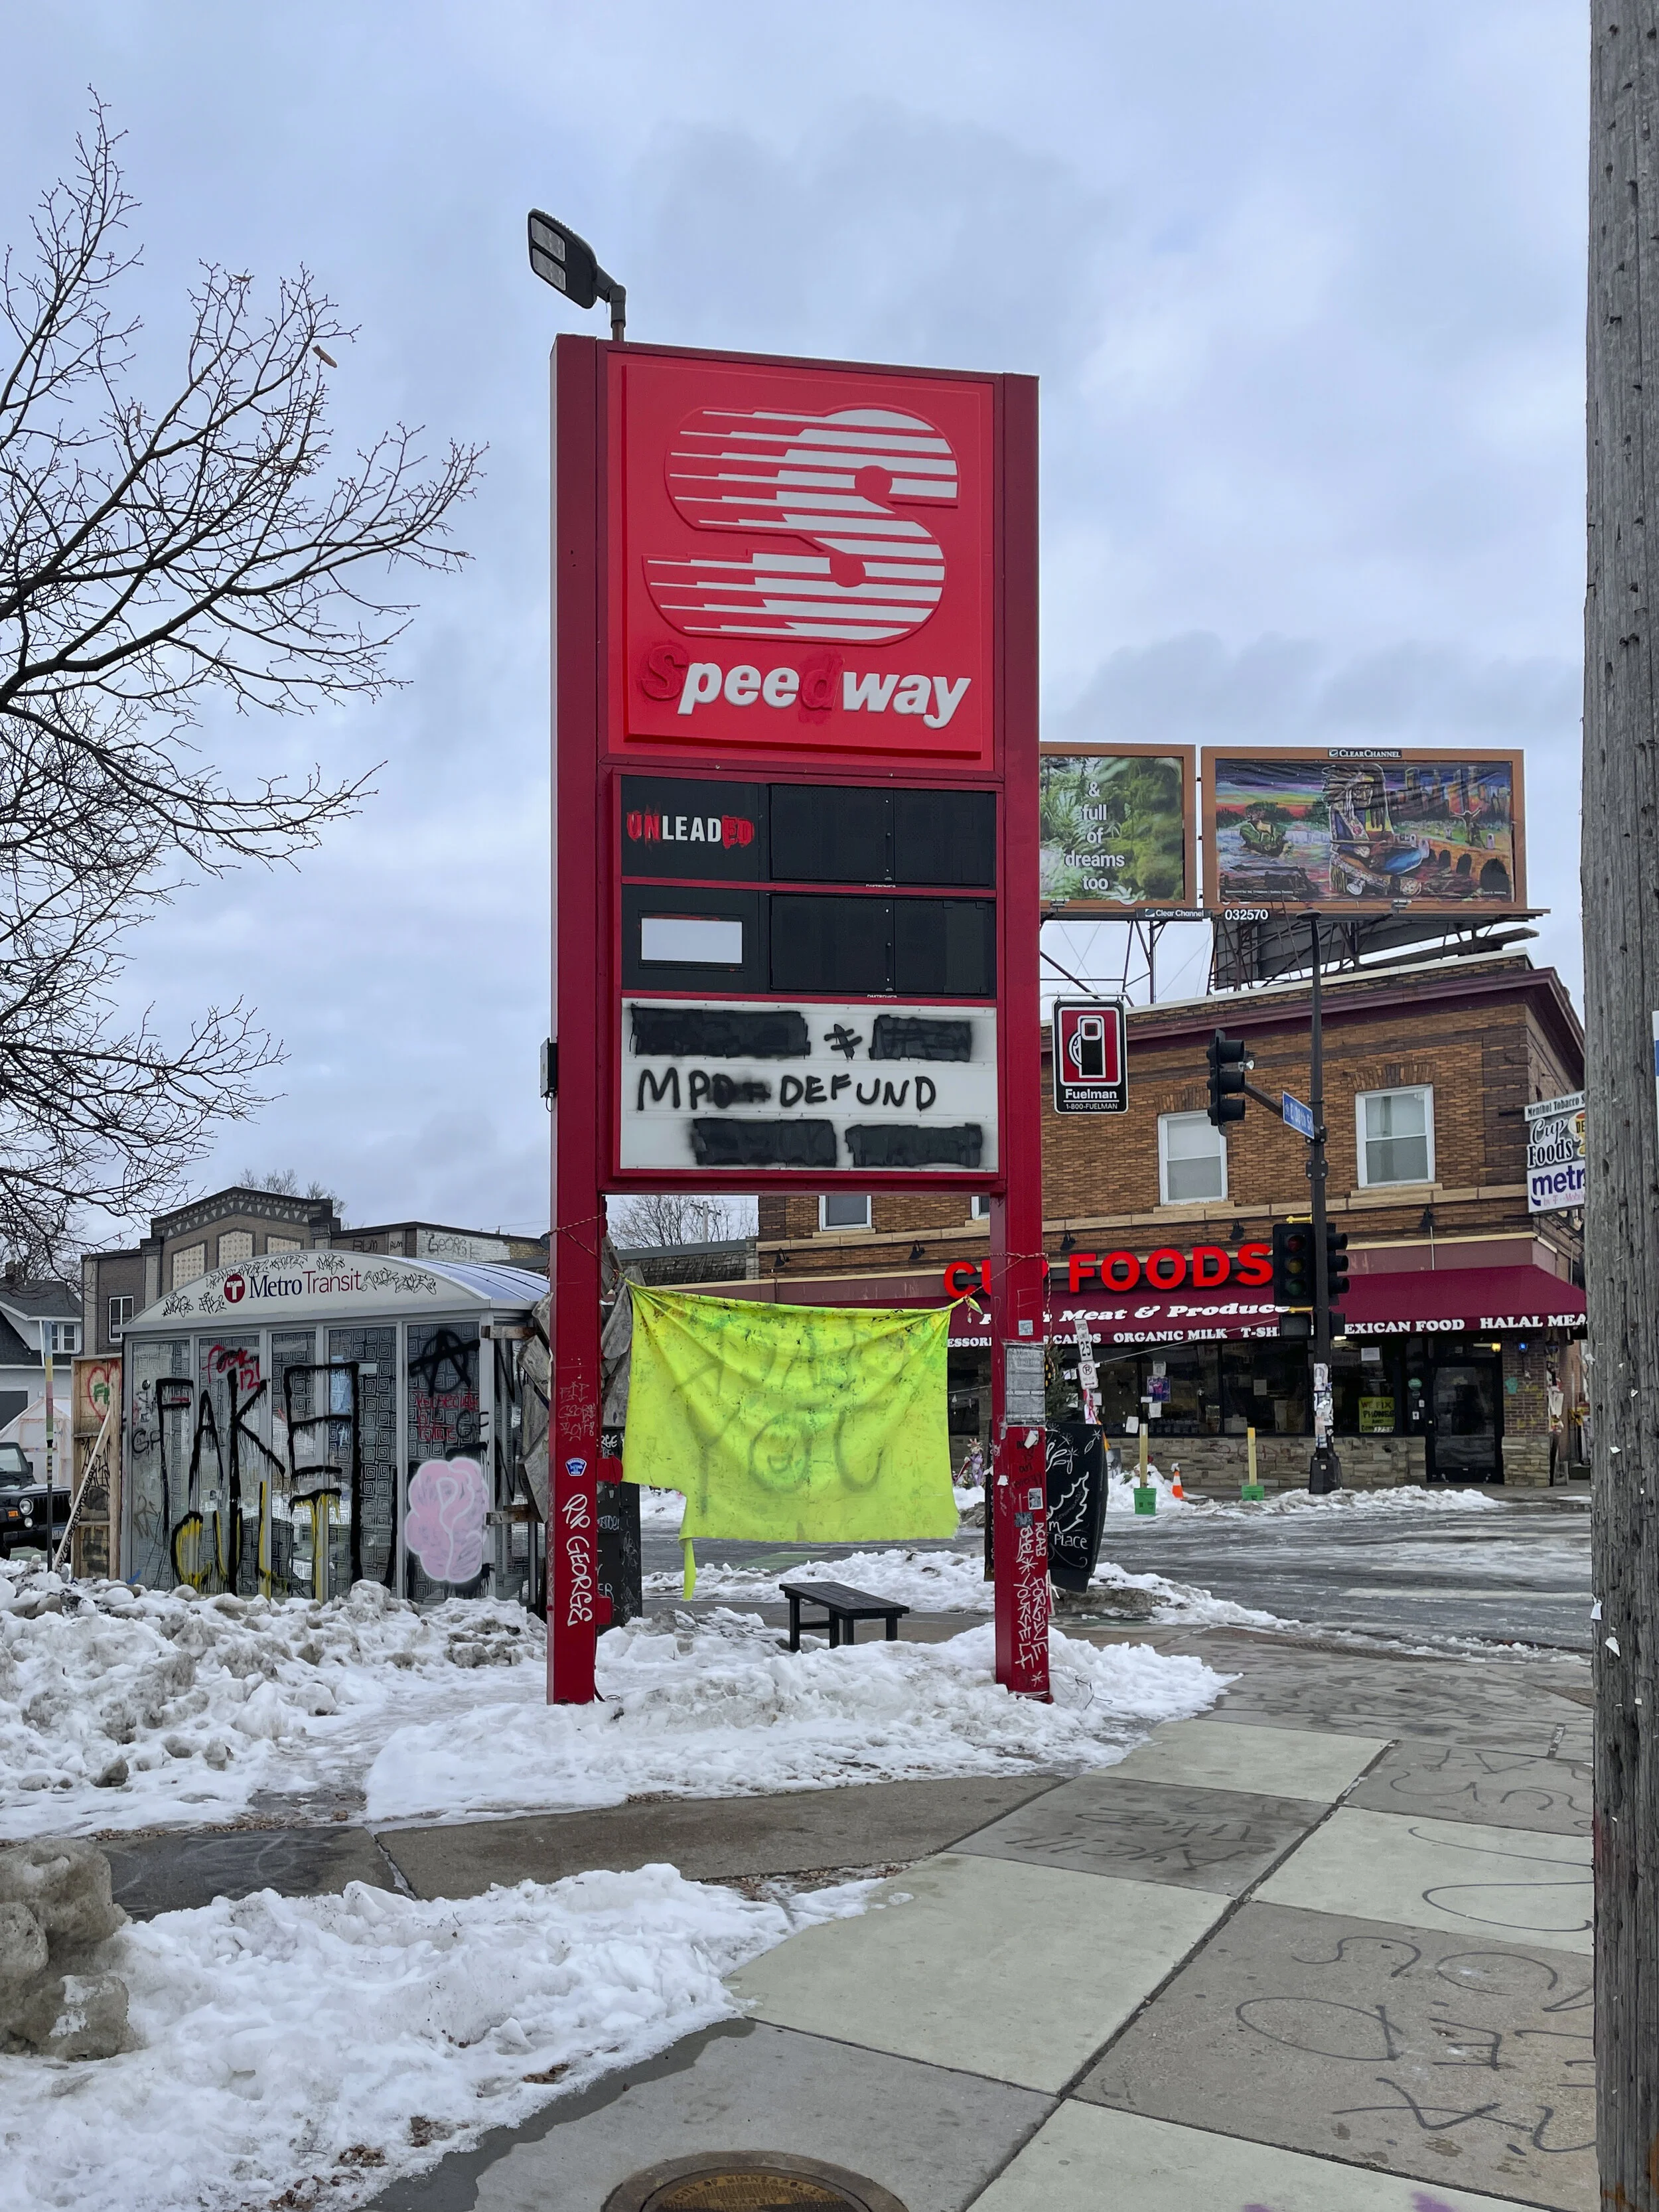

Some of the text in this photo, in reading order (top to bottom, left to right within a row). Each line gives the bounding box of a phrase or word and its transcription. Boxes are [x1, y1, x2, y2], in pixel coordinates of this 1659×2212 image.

[1082, 804, 1107, 820] full
[1086, 828, 1103, 844] of
[1064, 851, 1125, 867] dreams
[1082, 875, 1109, 890] too
[1225, 909, 1268, 921] 032570
[780, 1073, 936, 1111] DEFUND
[1065, 1088, 1117, 1099] Fuelman
[1528, 1101, 1551, 1117] Menthol
[1553, 1097, 1579, 1112] Tobacco
[1532, 1119, 1567, 1144] Cup
[1528, 1138, 1573, 1167] Foods
[1532, 1165, 1585, 1196] metr
[1069, 1243, 1273, 1293] FOODS
[1060, 1309, 1127, 1322] Meat
[1134, 1305, 1161, 1319] &
[1167, 1303, 1291, 1317] Produce
[1344, 1313, 1587, 1335] EXICAN FOOD HALAL MEA
[1113, 1330, 1183, 1343] ORGANIC
[1187, 1328, 1228, 1341] MILK
[1080, 1341, 1091, 1357] 25
[1035, 1522, 1046, 1557] ACAB
